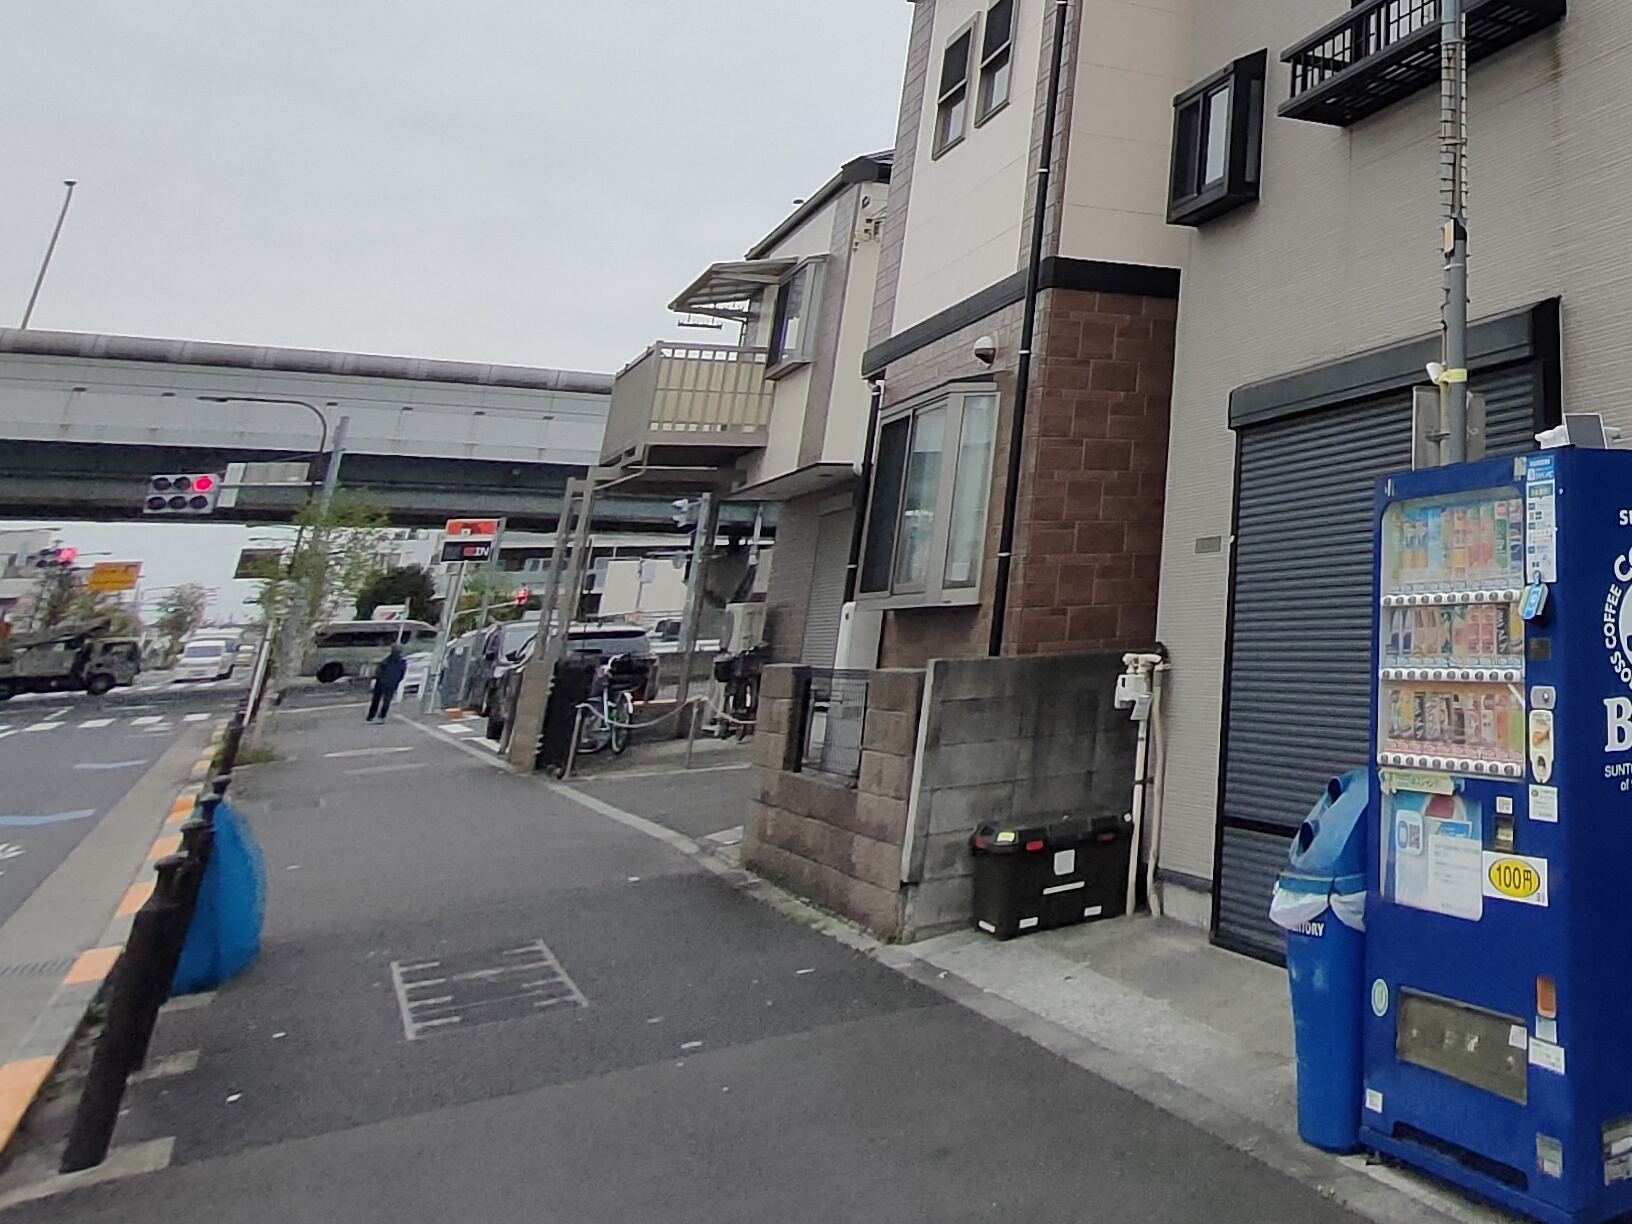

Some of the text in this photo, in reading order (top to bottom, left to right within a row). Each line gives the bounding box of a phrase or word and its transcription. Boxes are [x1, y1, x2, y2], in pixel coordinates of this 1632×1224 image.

[1603, 583, 1622, 649] COFFEE
[1620, 777, 1630, 792] of
[1496, 863, 1533, 891] 100円
